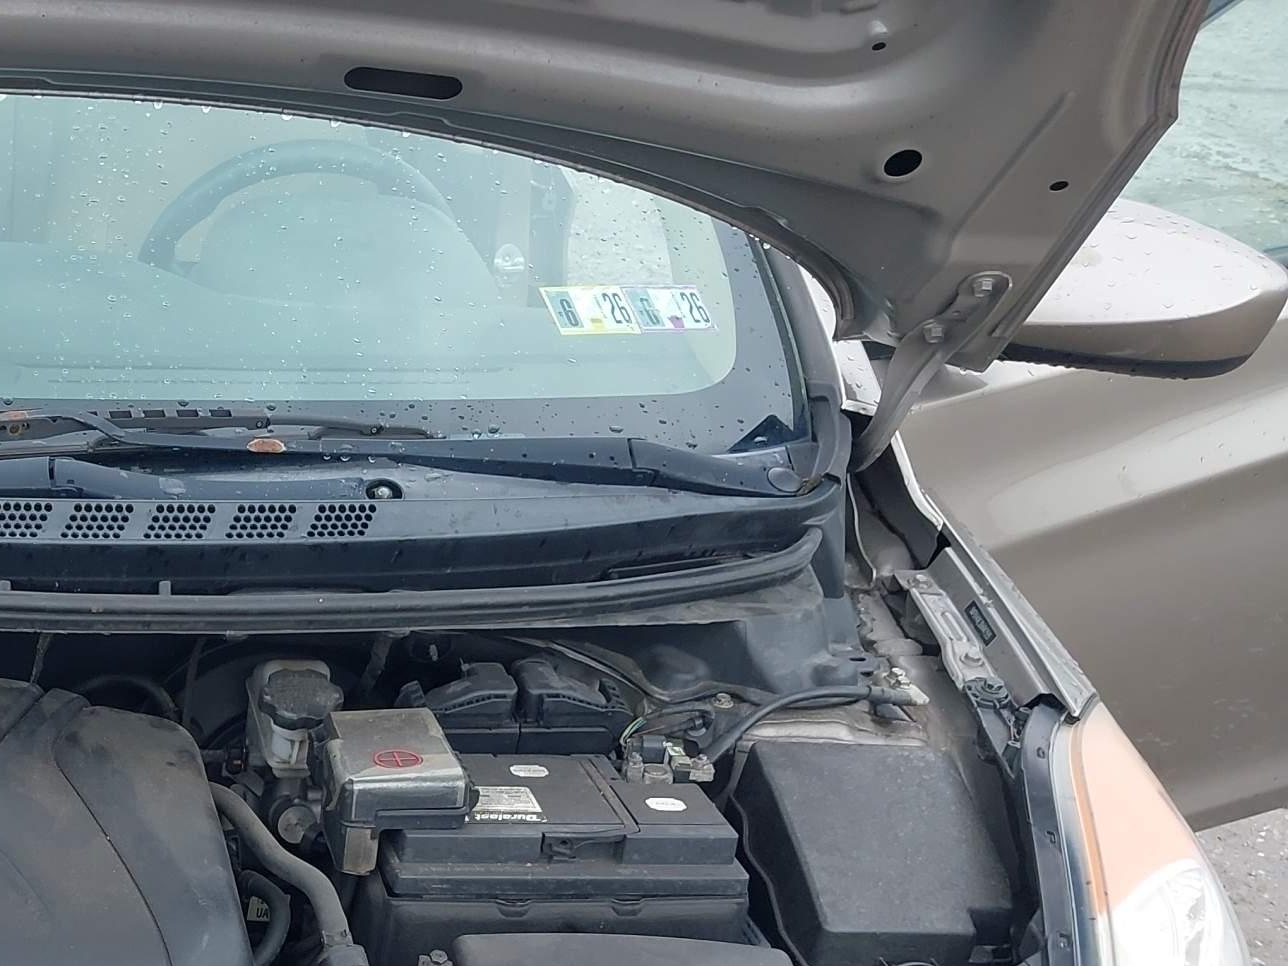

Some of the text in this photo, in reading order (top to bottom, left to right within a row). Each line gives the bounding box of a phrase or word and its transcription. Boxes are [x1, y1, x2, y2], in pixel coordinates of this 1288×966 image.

[559, 298, 580, 327] 6
[601, 292, 632, 325] 26
[679, 292, 711, 324] 26
